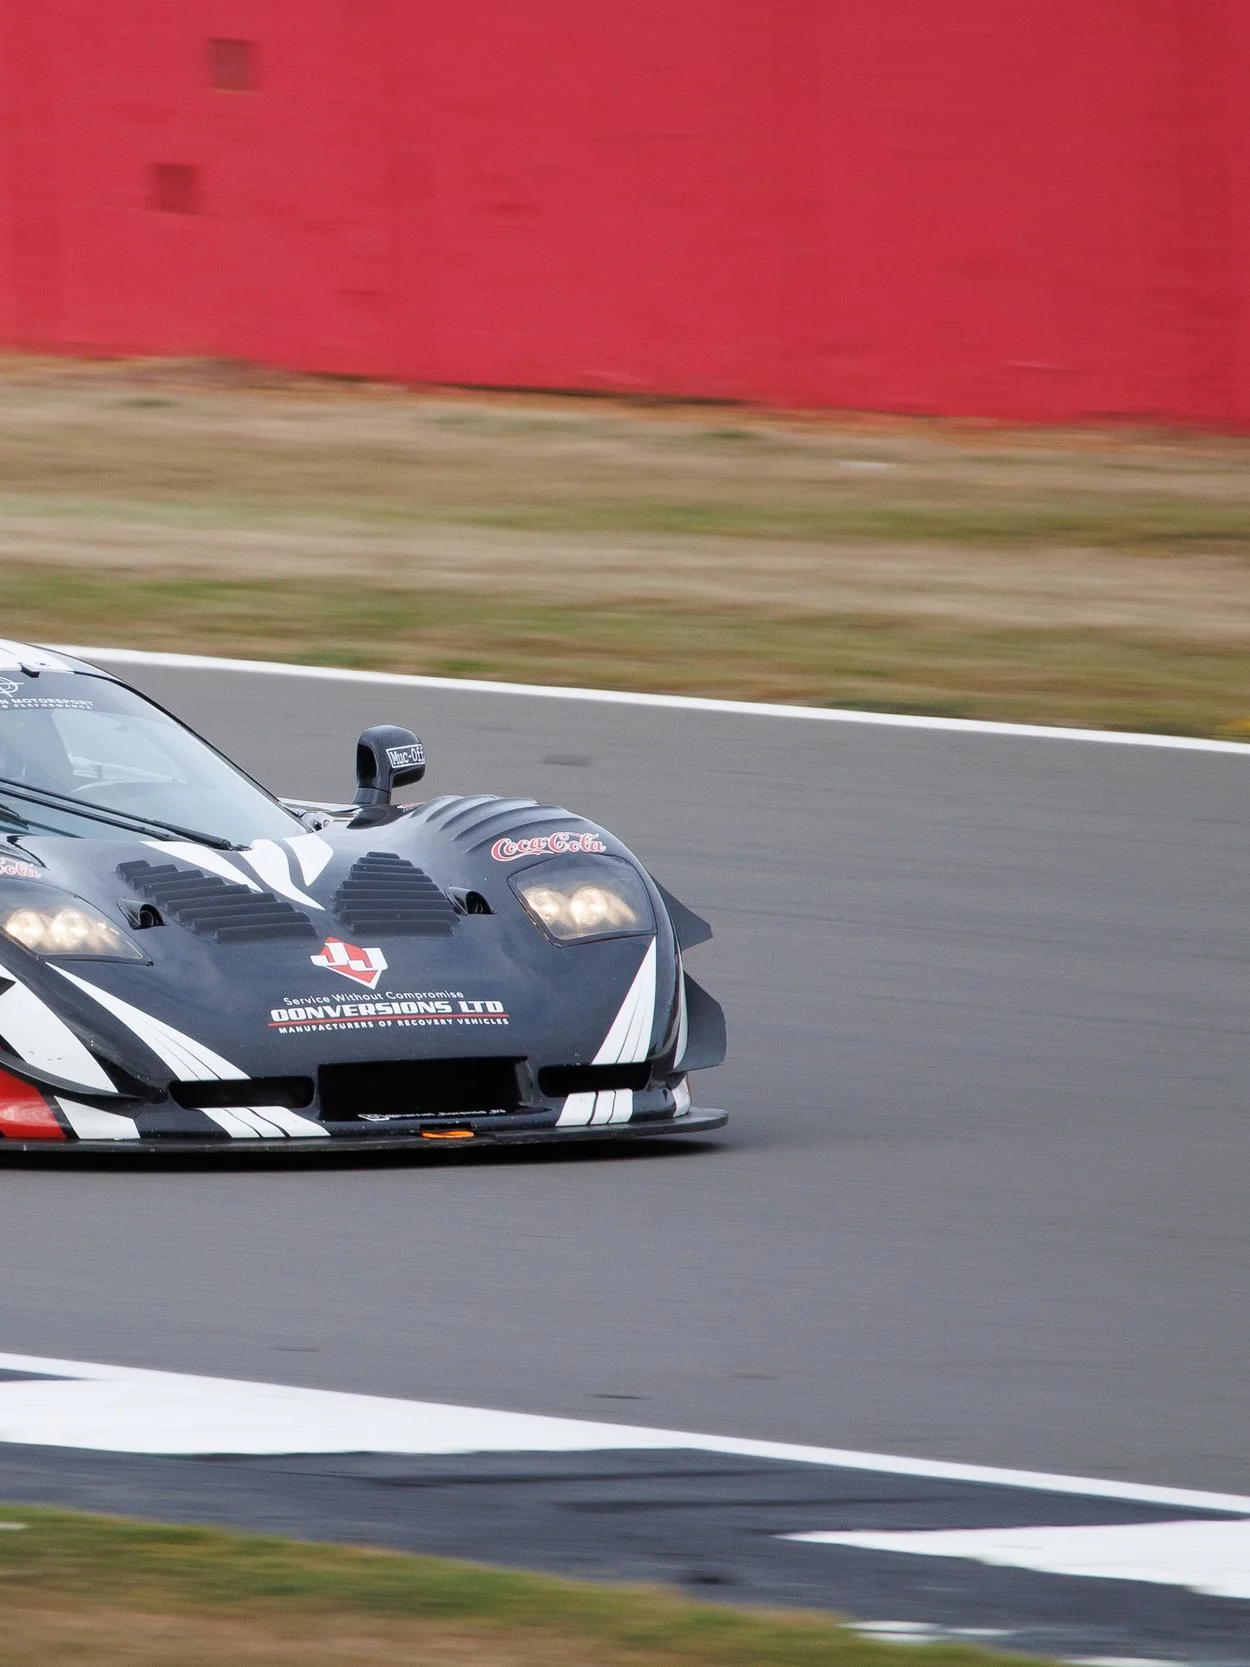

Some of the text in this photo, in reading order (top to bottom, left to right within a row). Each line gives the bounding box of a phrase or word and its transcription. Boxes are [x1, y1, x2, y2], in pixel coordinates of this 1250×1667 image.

[10, 698, 94, 707] MOTORSPORT
[491, 832, 607, 861] Coca-Cola
[283, 990, 464, 1006] Service Without Compromise
[270, 1000, 504, 1022] CONVERSIONS LTD
[279, 1021, 374, 1034] MANUFACTURERS
[378, 1019, 392, 1028] OF
[397, 1018, 453, 1027] RECOVERY
